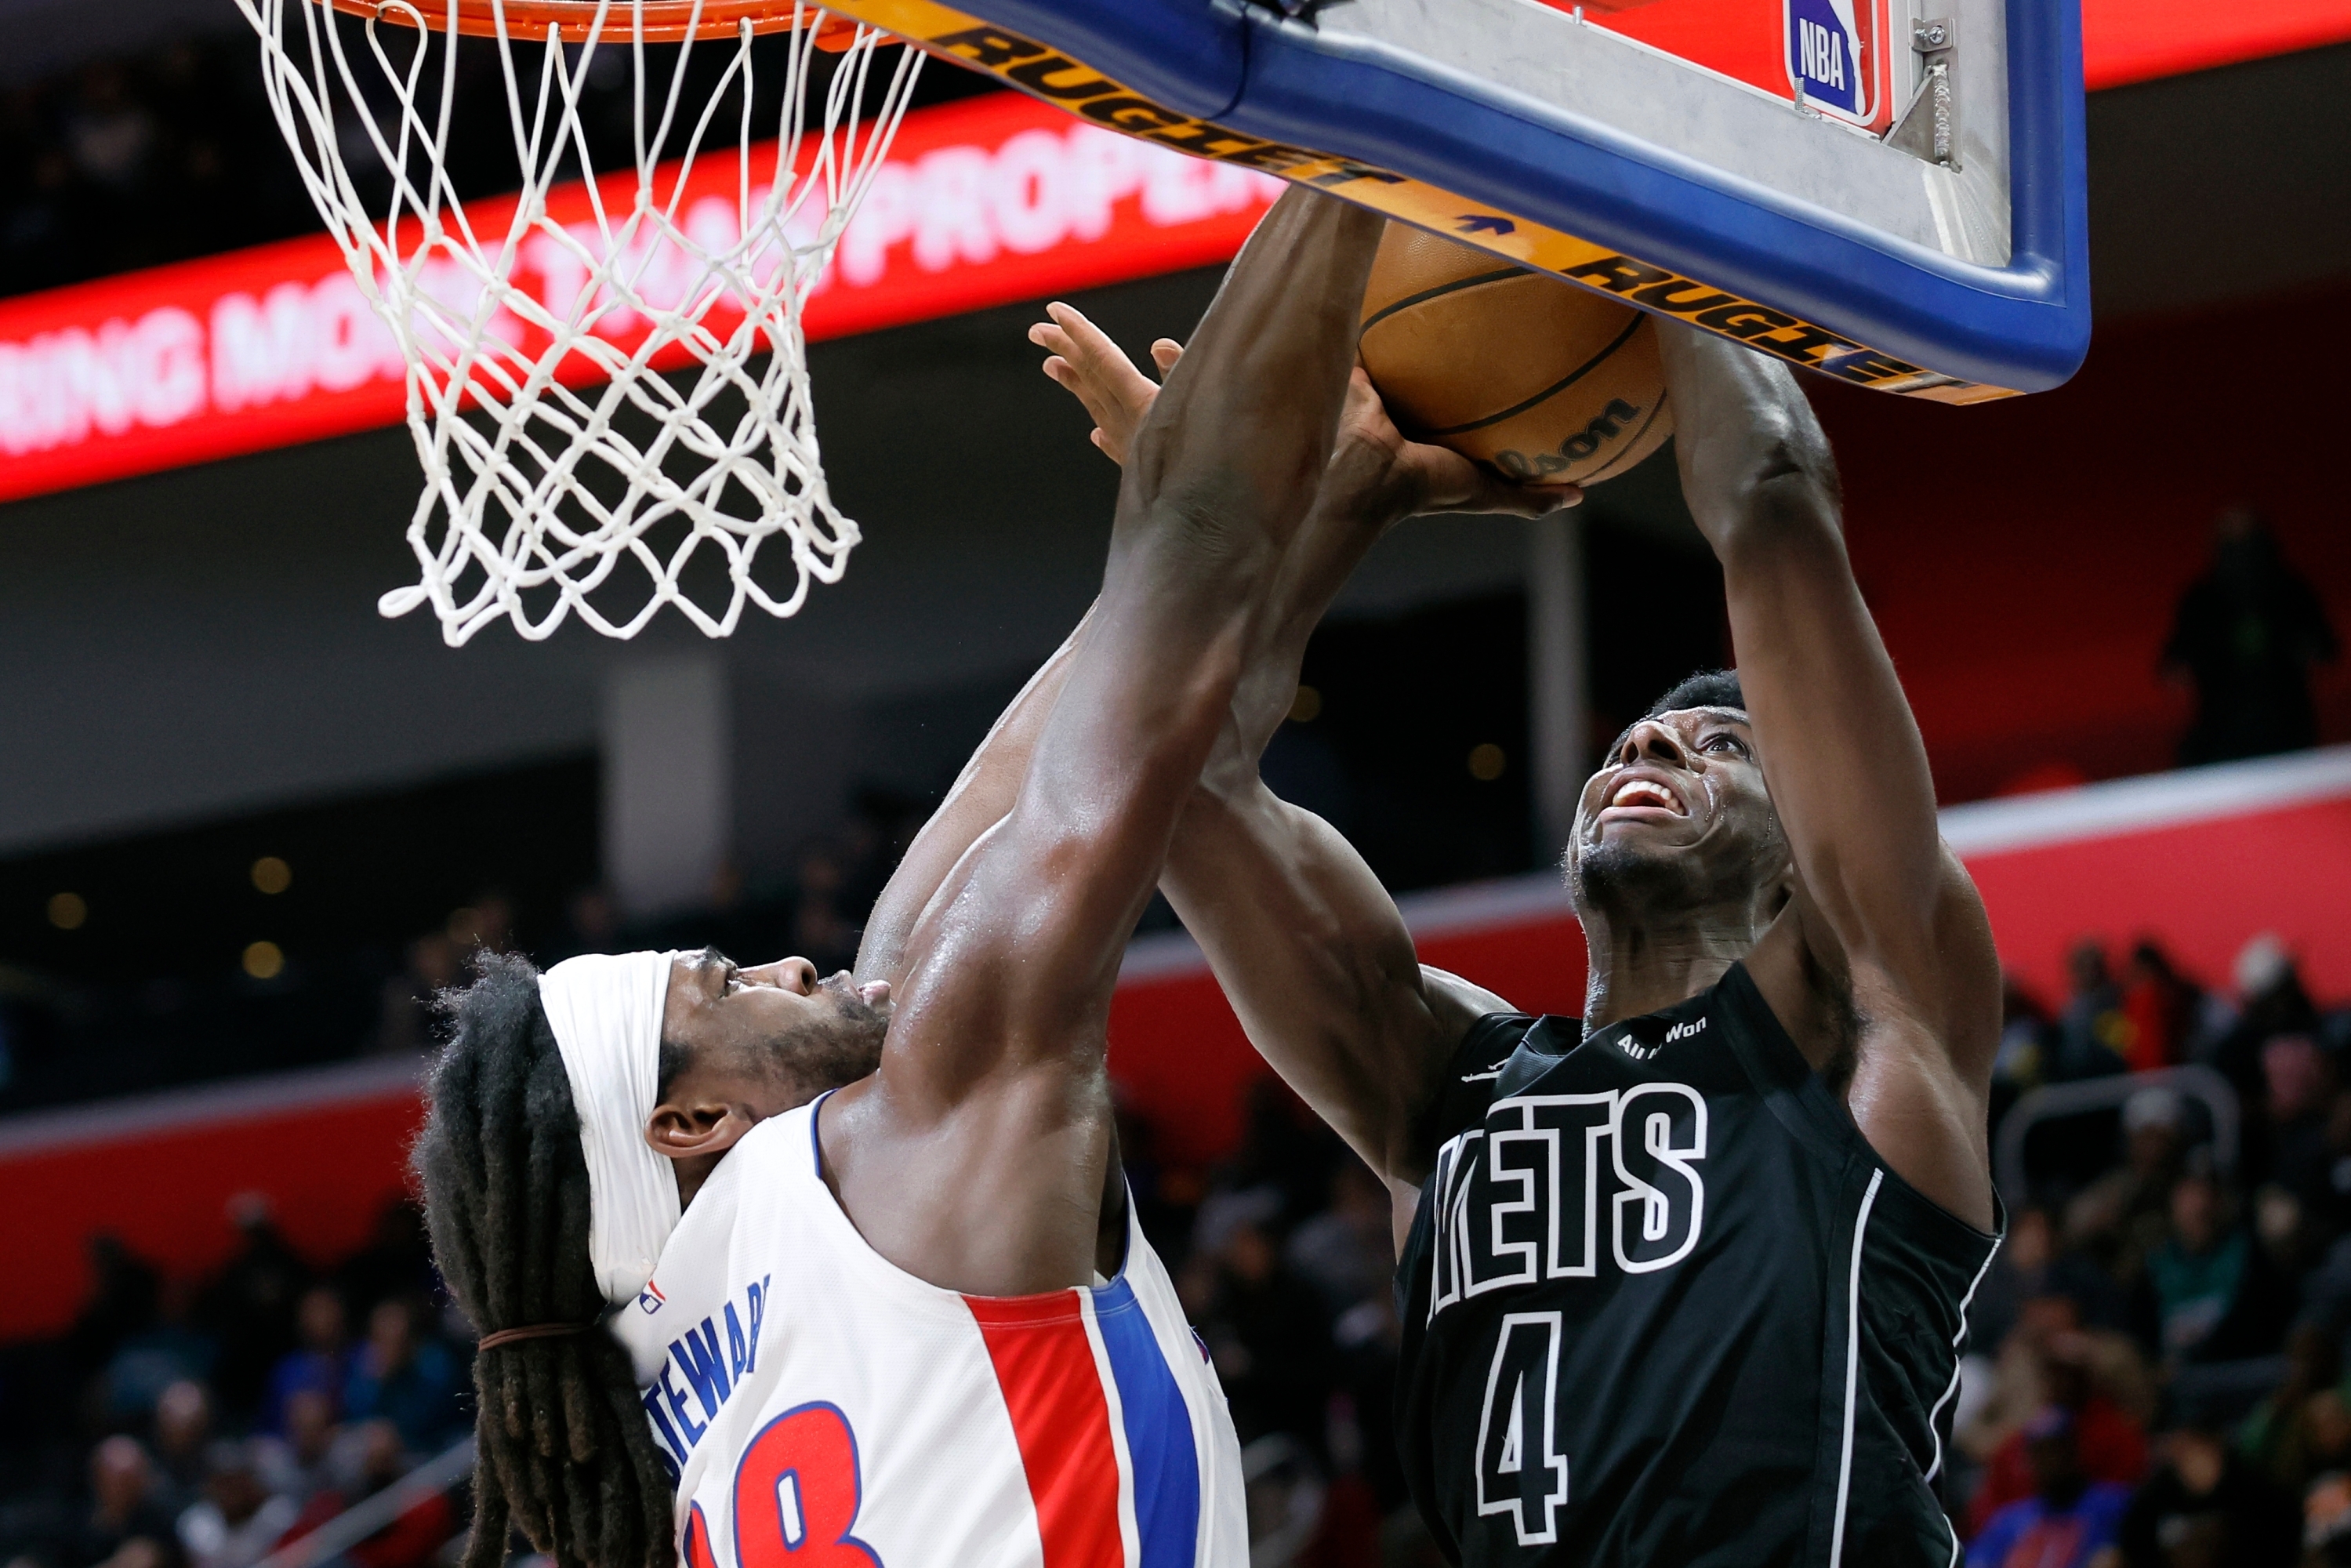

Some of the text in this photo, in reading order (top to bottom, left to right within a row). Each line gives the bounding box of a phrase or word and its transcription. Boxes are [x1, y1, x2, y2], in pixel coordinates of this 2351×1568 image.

[931, 26, 1410, 186] RUGIET
[1799, 17, 1845, 92] NBA
[1559, 256, 1980, 394] RUGIET
[1494, 398, 1641, 481] lson
[1617, 1033, 1645, 1060] All
[1666, 1016, 1707, 1044] Won
[1476, 1311, 1567, 1547] 4
